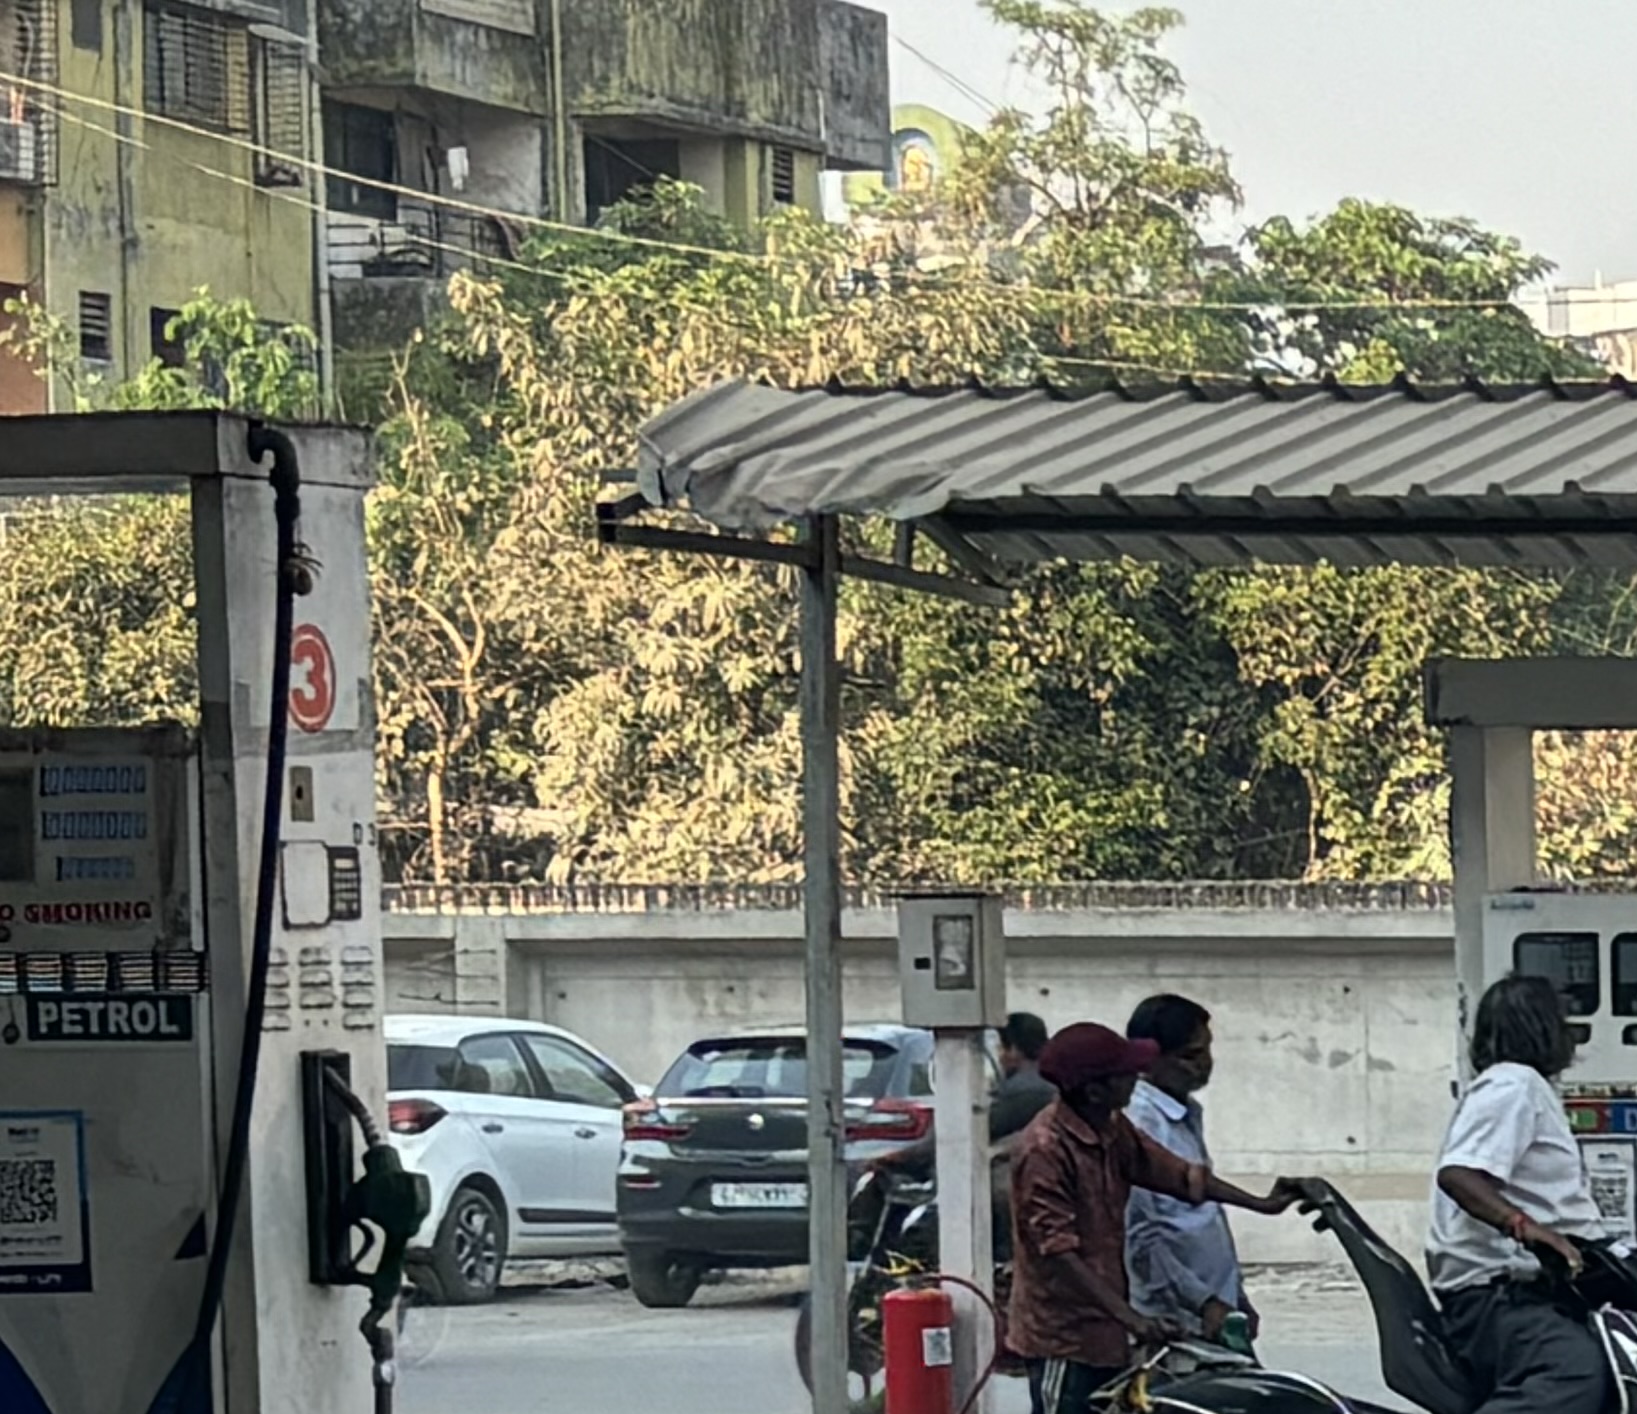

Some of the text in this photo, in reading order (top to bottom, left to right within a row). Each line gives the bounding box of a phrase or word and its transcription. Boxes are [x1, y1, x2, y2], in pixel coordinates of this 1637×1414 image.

[291, 638, 329, 718] 3
[24, 901, 152, 924] SMOKING
[37, 1001, 180, 1035] PETROL
